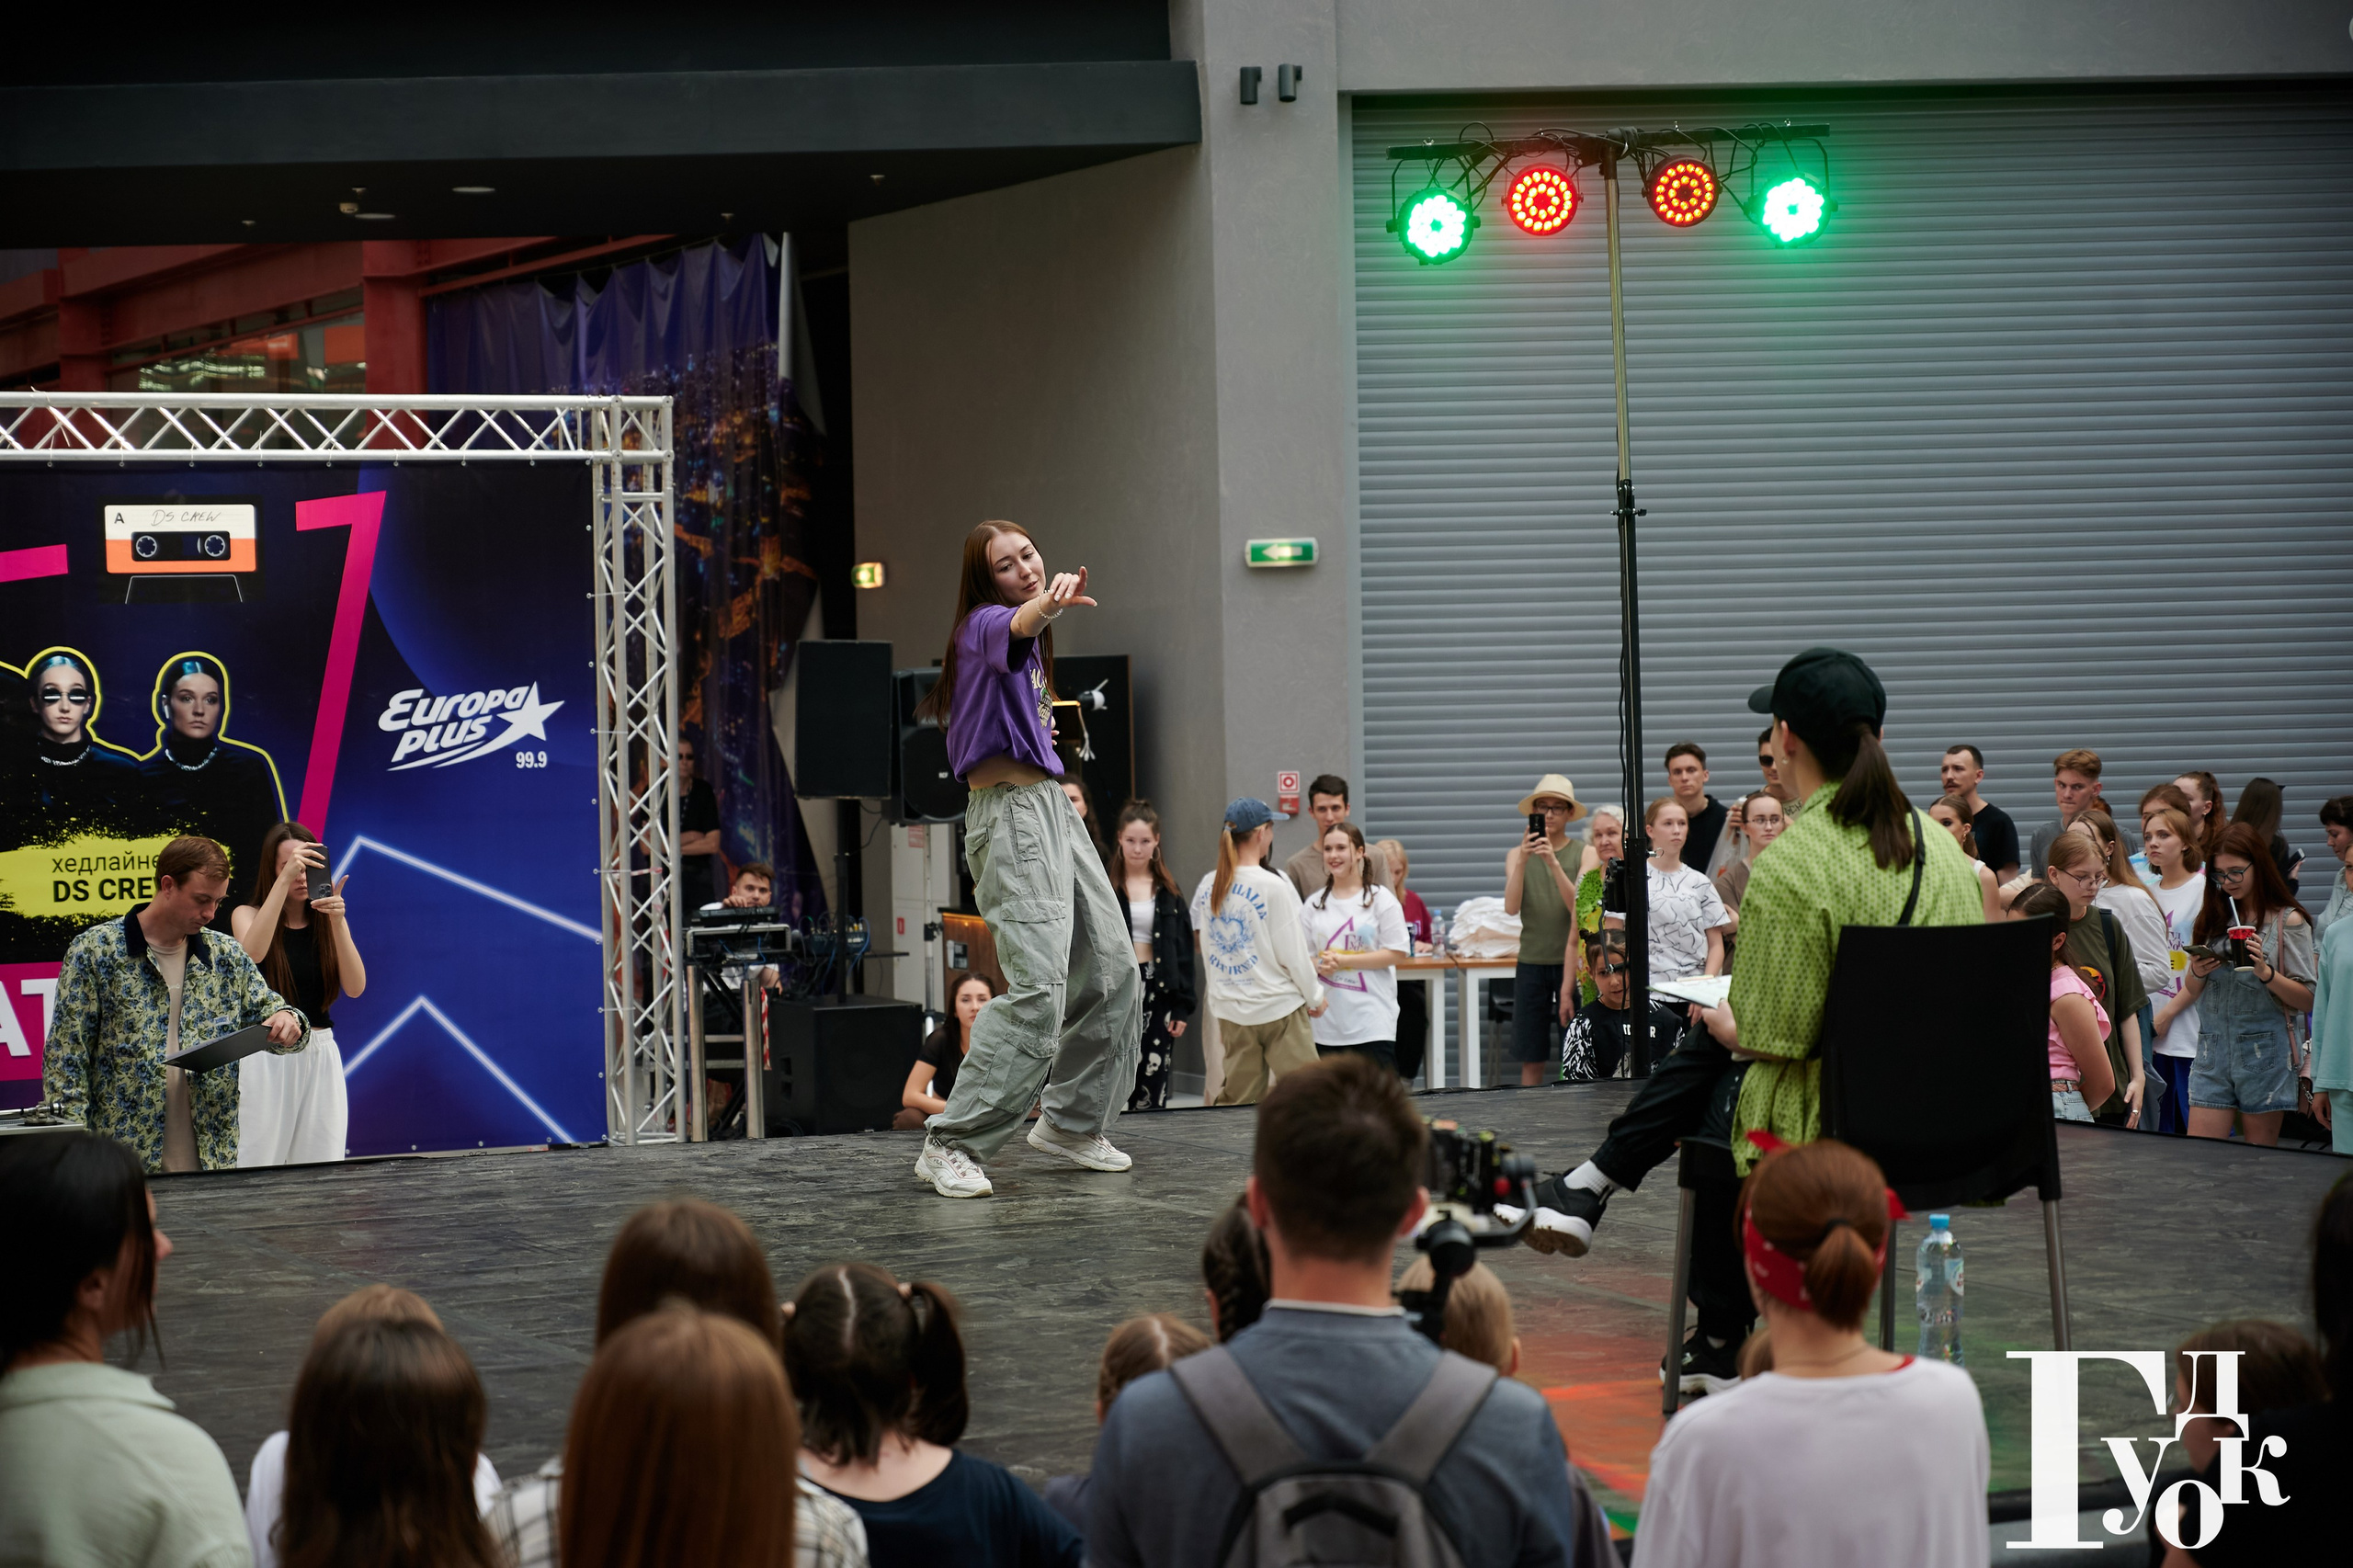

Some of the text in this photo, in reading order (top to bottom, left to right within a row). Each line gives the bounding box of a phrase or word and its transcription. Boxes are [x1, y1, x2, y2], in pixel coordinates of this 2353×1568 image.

[114, 512, 125, 525] A
[151, 509, 222, 527] DS CREW
[378, 686, 529, 732] Europa
[391, 715, 493, 763] plus
[516, 751, 548, 769] 99.9
[51, 850, 158, 876] хедлайне
[53, 877, 156, 903] DS CRE
